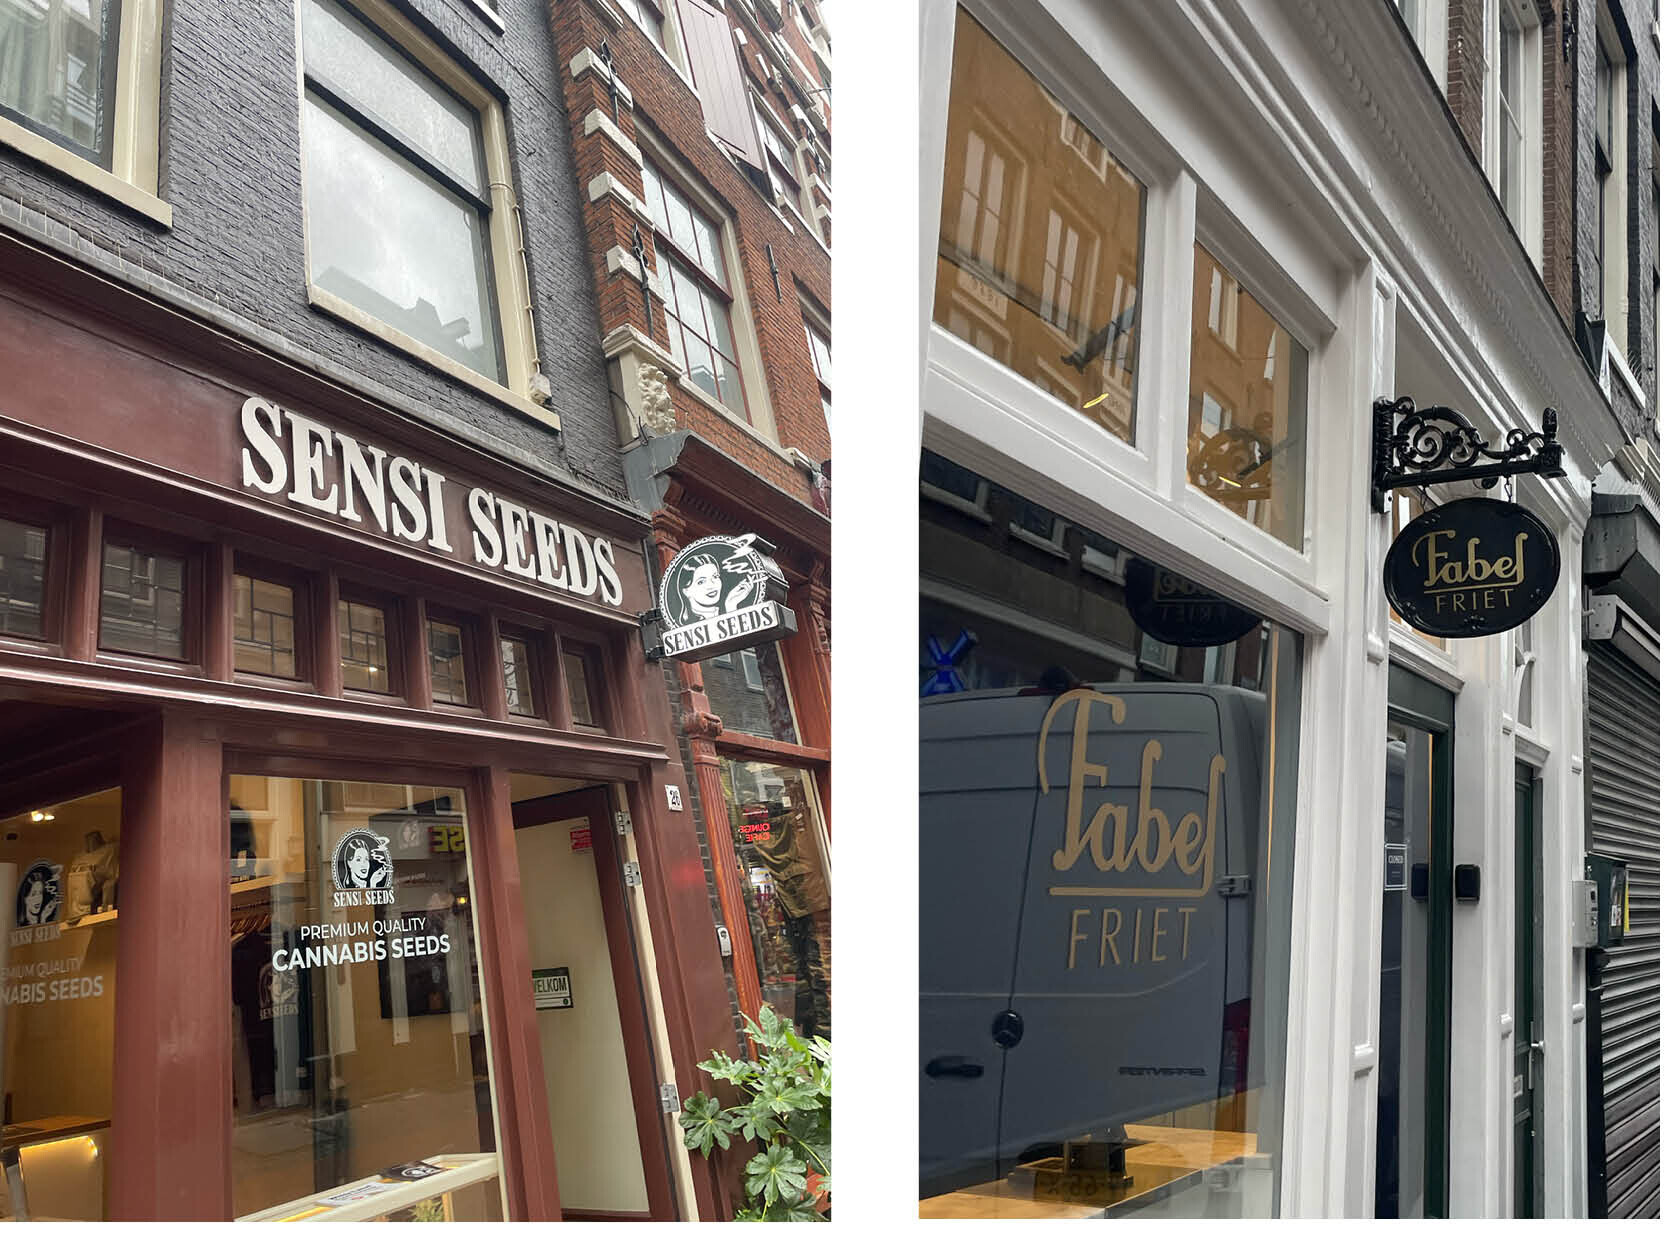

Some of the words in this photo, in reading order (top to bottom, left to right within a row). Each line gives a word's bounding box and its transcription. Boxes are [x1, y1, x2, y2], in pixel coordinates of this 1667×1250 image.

[241, 397, 453, 553] SENSI
[468, 487, 623, 607] SEEDS
[1411, 528, 1529, 588] Fabel
[1435, 589, 1513, 614] FRIET
[664, 624, 713, 655] SENSI
[716, 606, 774, 639] SEEDS
[1038, 688, 1227, 897] Fabel
[333, 890, 363, 908] SENSI
[365, 889, 395, 906] SEEDS
[300, 920, 369, 941] PREMIUM
[372, 917, 428, 937] QUALITY
[1067, 908, 1197, 969] FRIET
[272, 939, 387, 972] CANNABIS
[391, 934, 451, 959] SEEDS
[49, 976, 104, 1000] SEEDS
[534, 977, 568, 993] ELKOM
